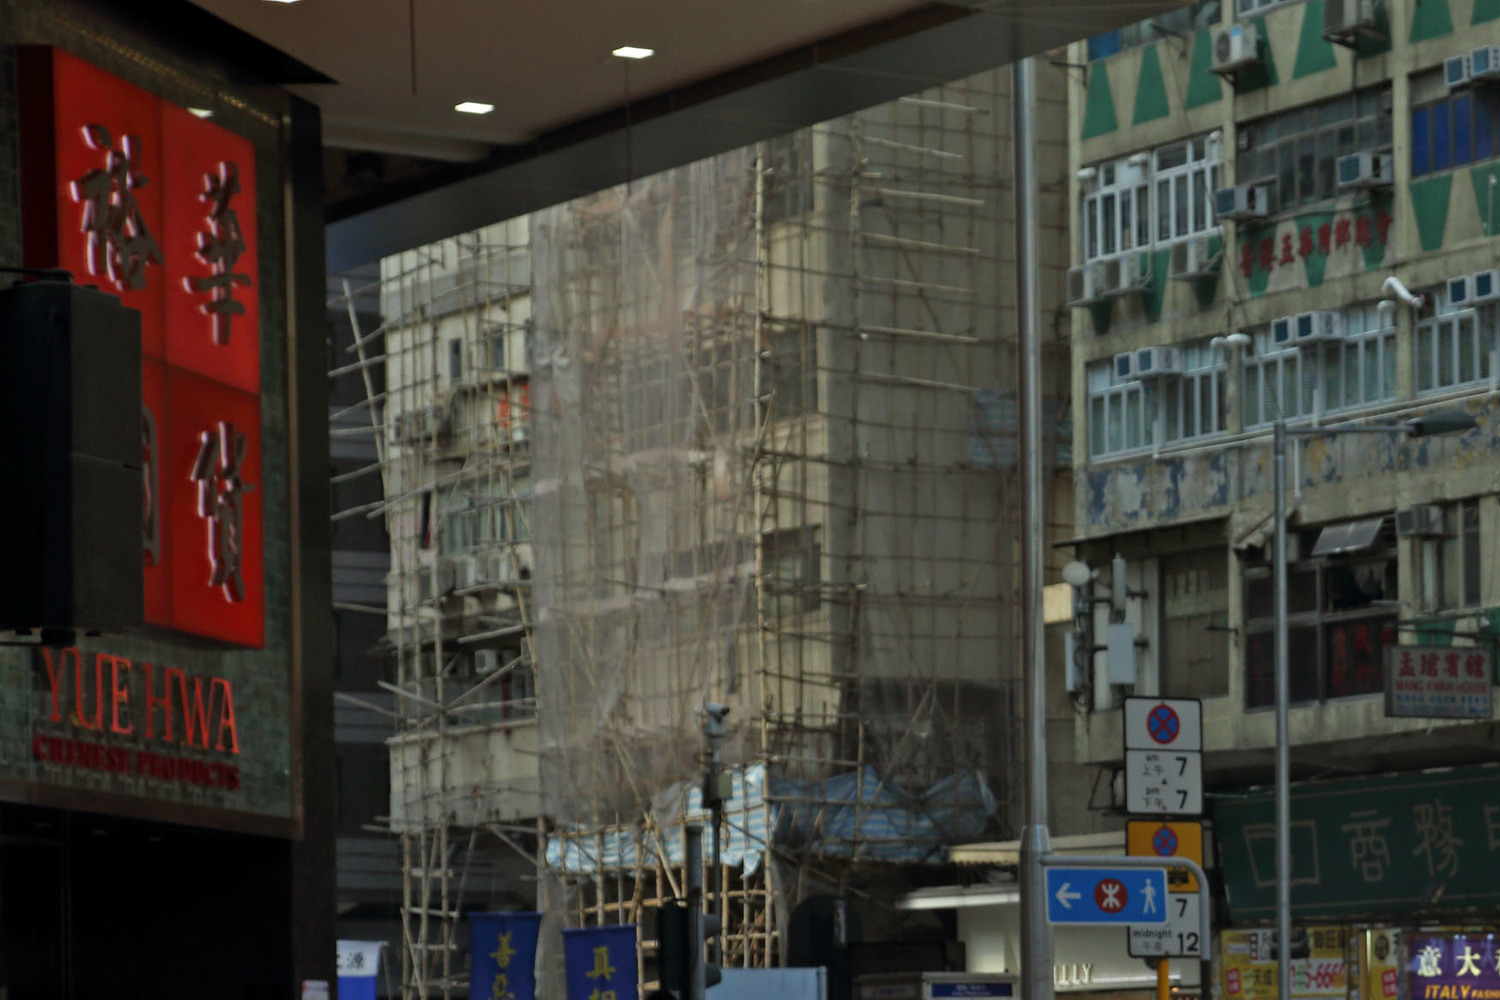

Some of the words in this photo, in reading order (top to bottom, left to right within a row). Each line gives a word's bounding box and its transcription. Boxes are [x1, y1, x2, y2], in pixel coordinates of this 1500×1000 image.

[42, 645, 133, 735] YUE
[143, 662, 241, 755] HWA
[1175, 757, 1187, 776] 7
[1176, 790, 1188, 809] 7
[1176, 898, 1187, 917] 7
[1133, 929, 1172, 941] midnight
[1177, 932, 1199, 953] 12
[1424, 984, 1471, 1000] ITALY
